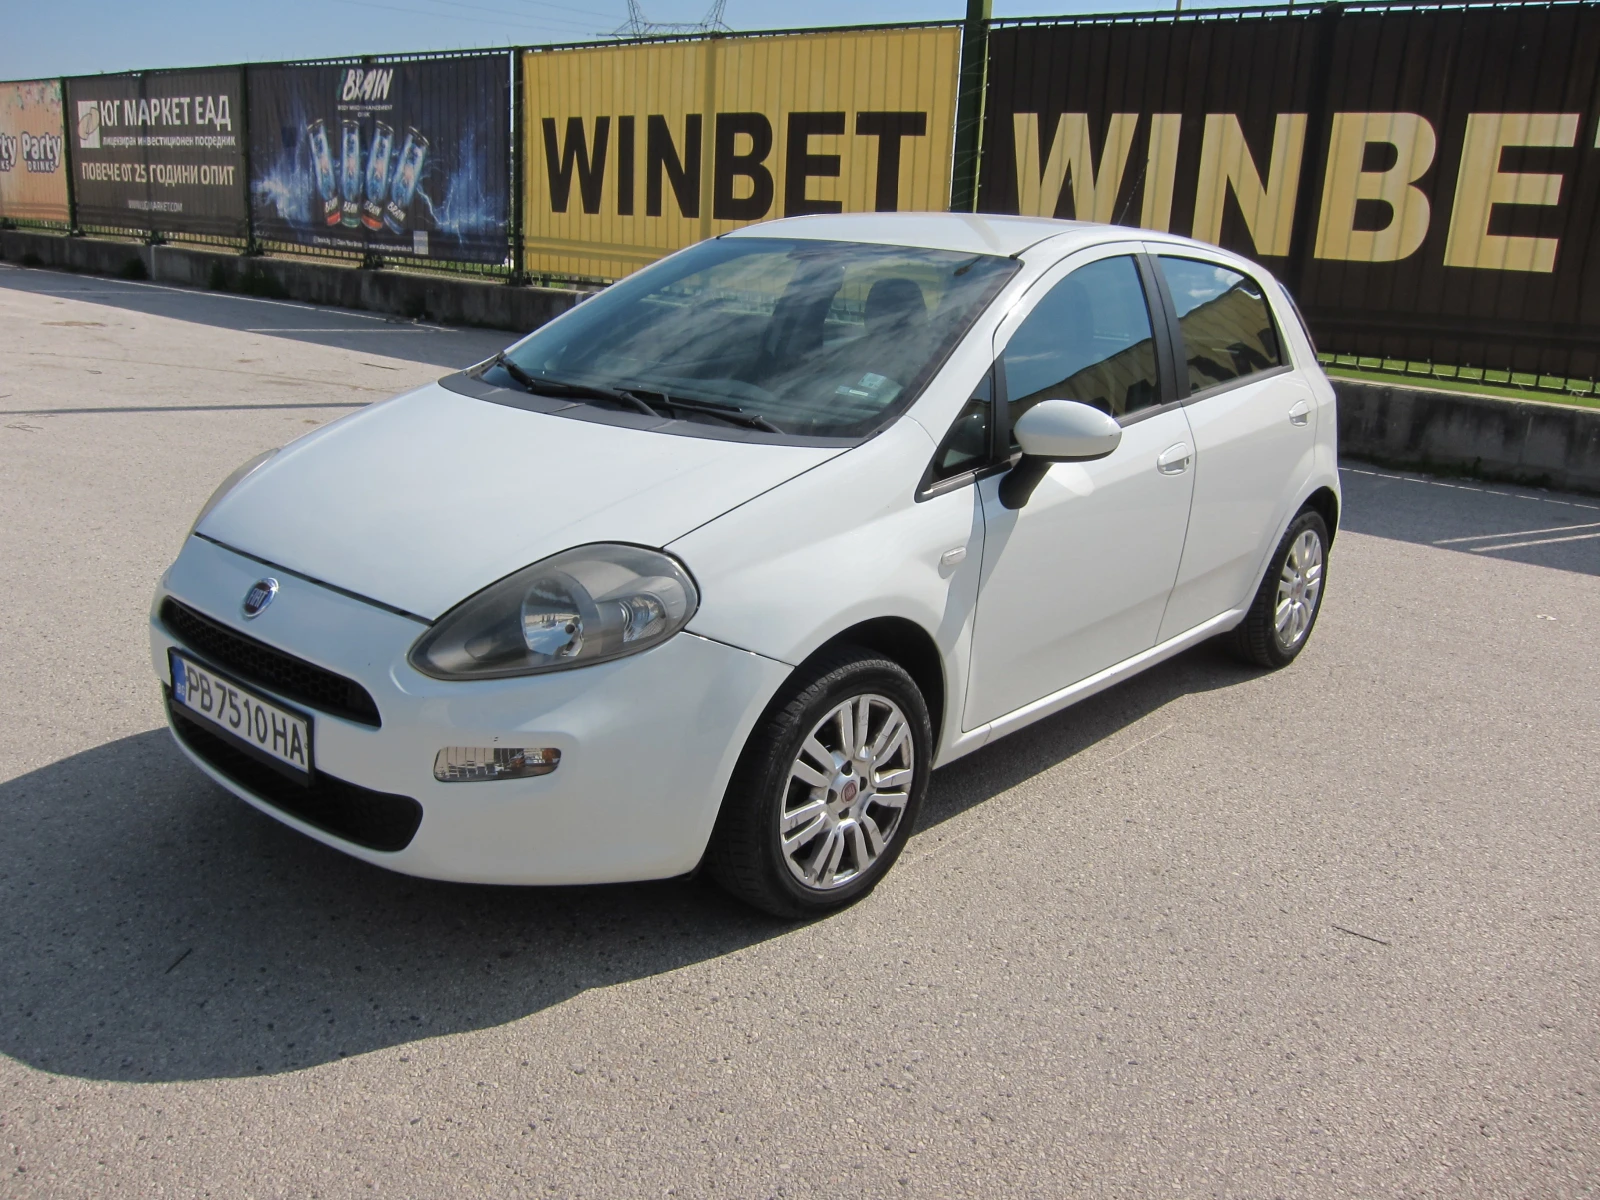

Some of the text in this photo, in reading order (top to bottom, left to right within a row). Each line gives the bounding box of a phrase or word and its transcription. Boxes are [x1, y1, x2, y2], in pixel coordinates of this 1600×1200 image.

[343, 68, 394, 101] BRAIN
[100, 95, 232, 132] ЮГ МАРКЕТ ЕАД
[22, 131, 62, 168] Party
[195, 135, 236, 149] посредник
[27, 160, 55, 172] DRINKS
[82, 162, 235, 187] ПОВЕЧЕ ОТ 25 ГОДИНИ ОПИТ
[542, 111, 928, 220] WINBET
[1013, 112, 1600, 273] WINBE
[176, 682, 185, 696] BG
